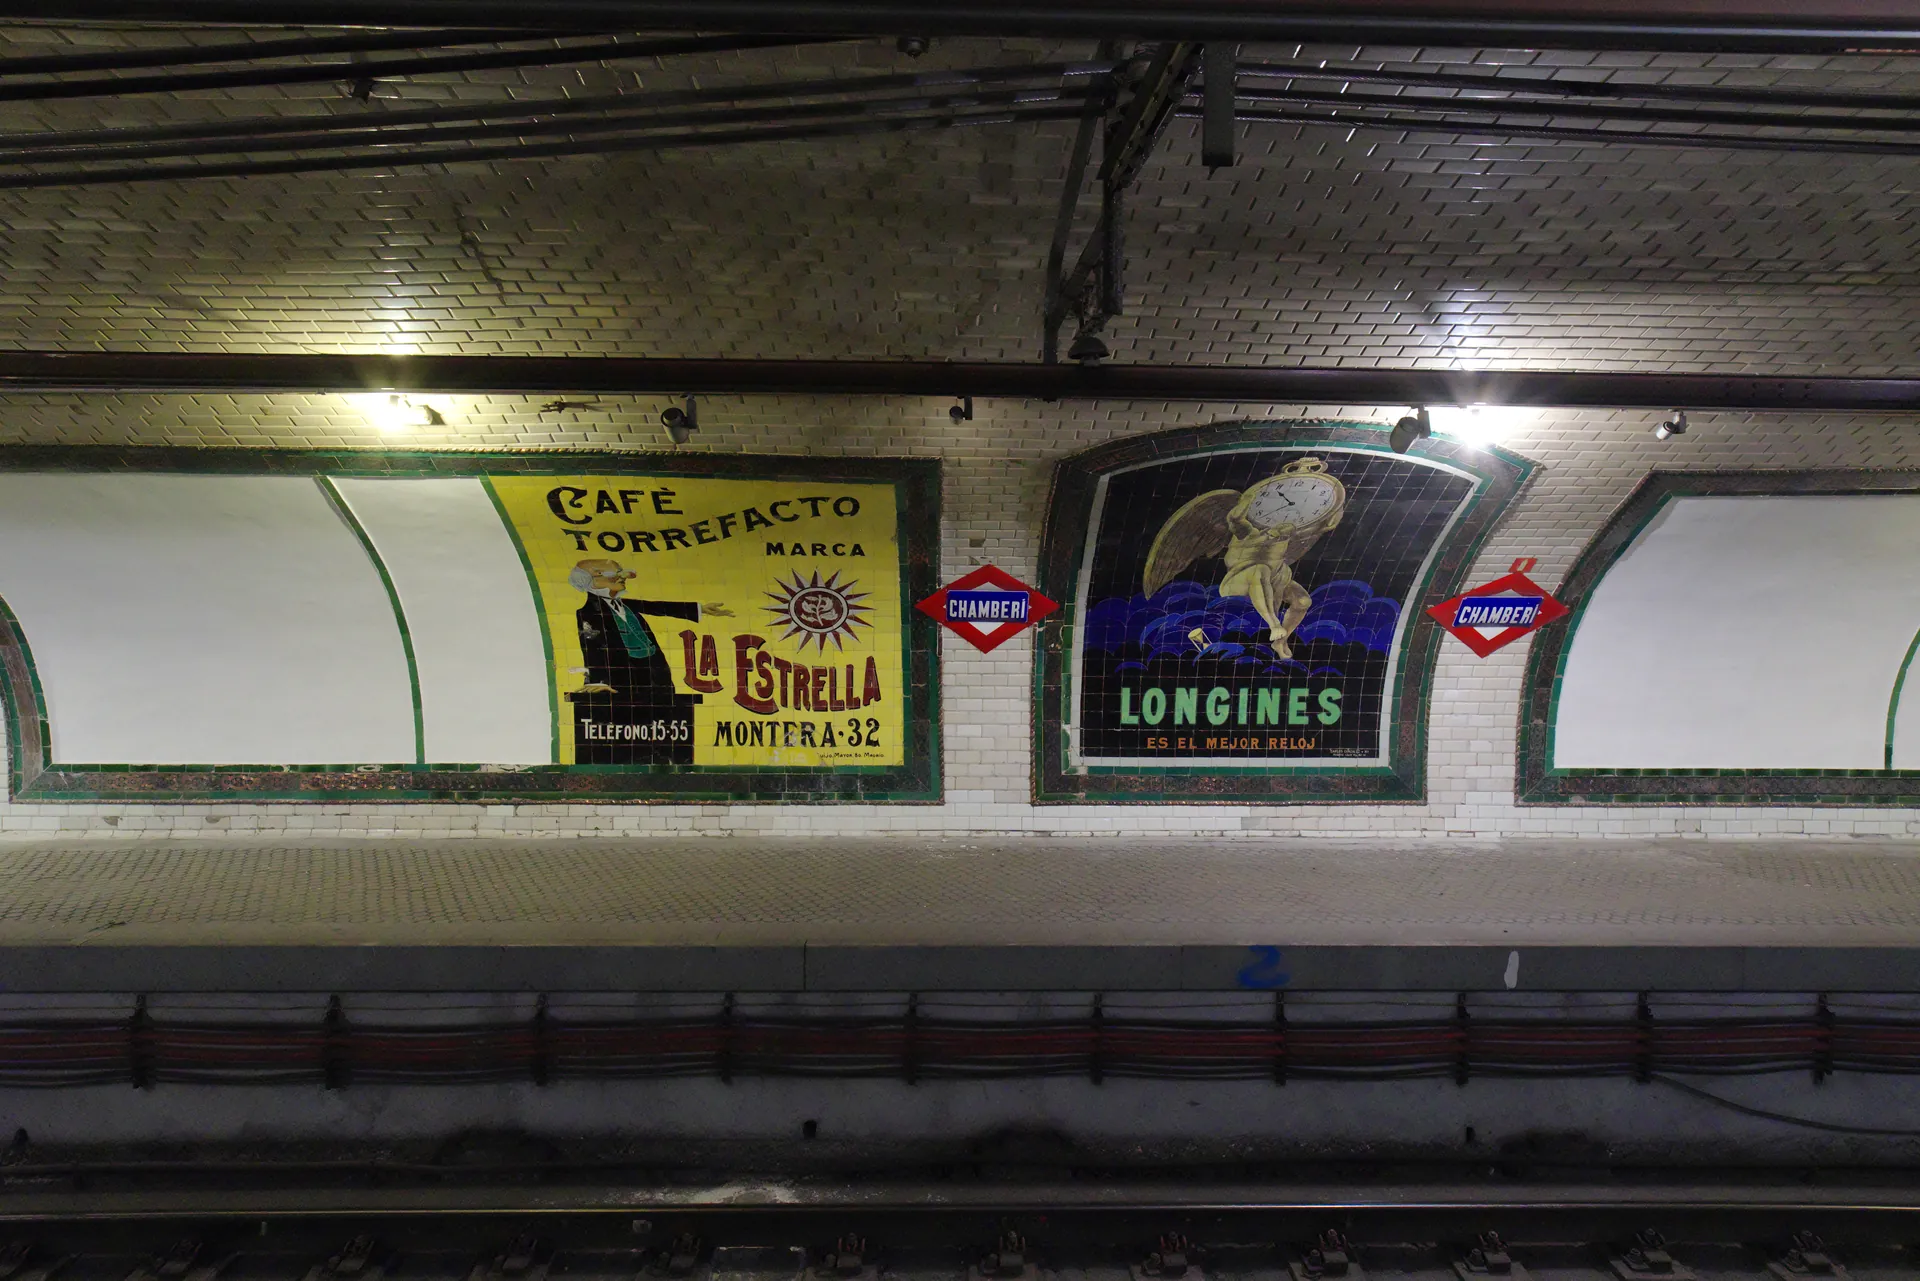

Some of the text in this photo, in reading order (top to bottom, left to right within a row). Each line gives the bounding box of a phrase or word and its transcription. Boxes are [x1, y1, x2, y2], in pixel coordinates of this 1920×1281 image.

[562, 496, 860, 553] TORREFACTO
[766, 542, 866, 557] MARCA
[949, 598, 1026, 619] CHAMBERÍ
[1458, 604, 1540, 625] CHAMBERÍ
[679, 629, 882, 716] LA ESTRELLA
[1120, 686, 1343, 726] LONGINES
[1147, 737, 1316, 750] ES EL MEJOR RELOJ
